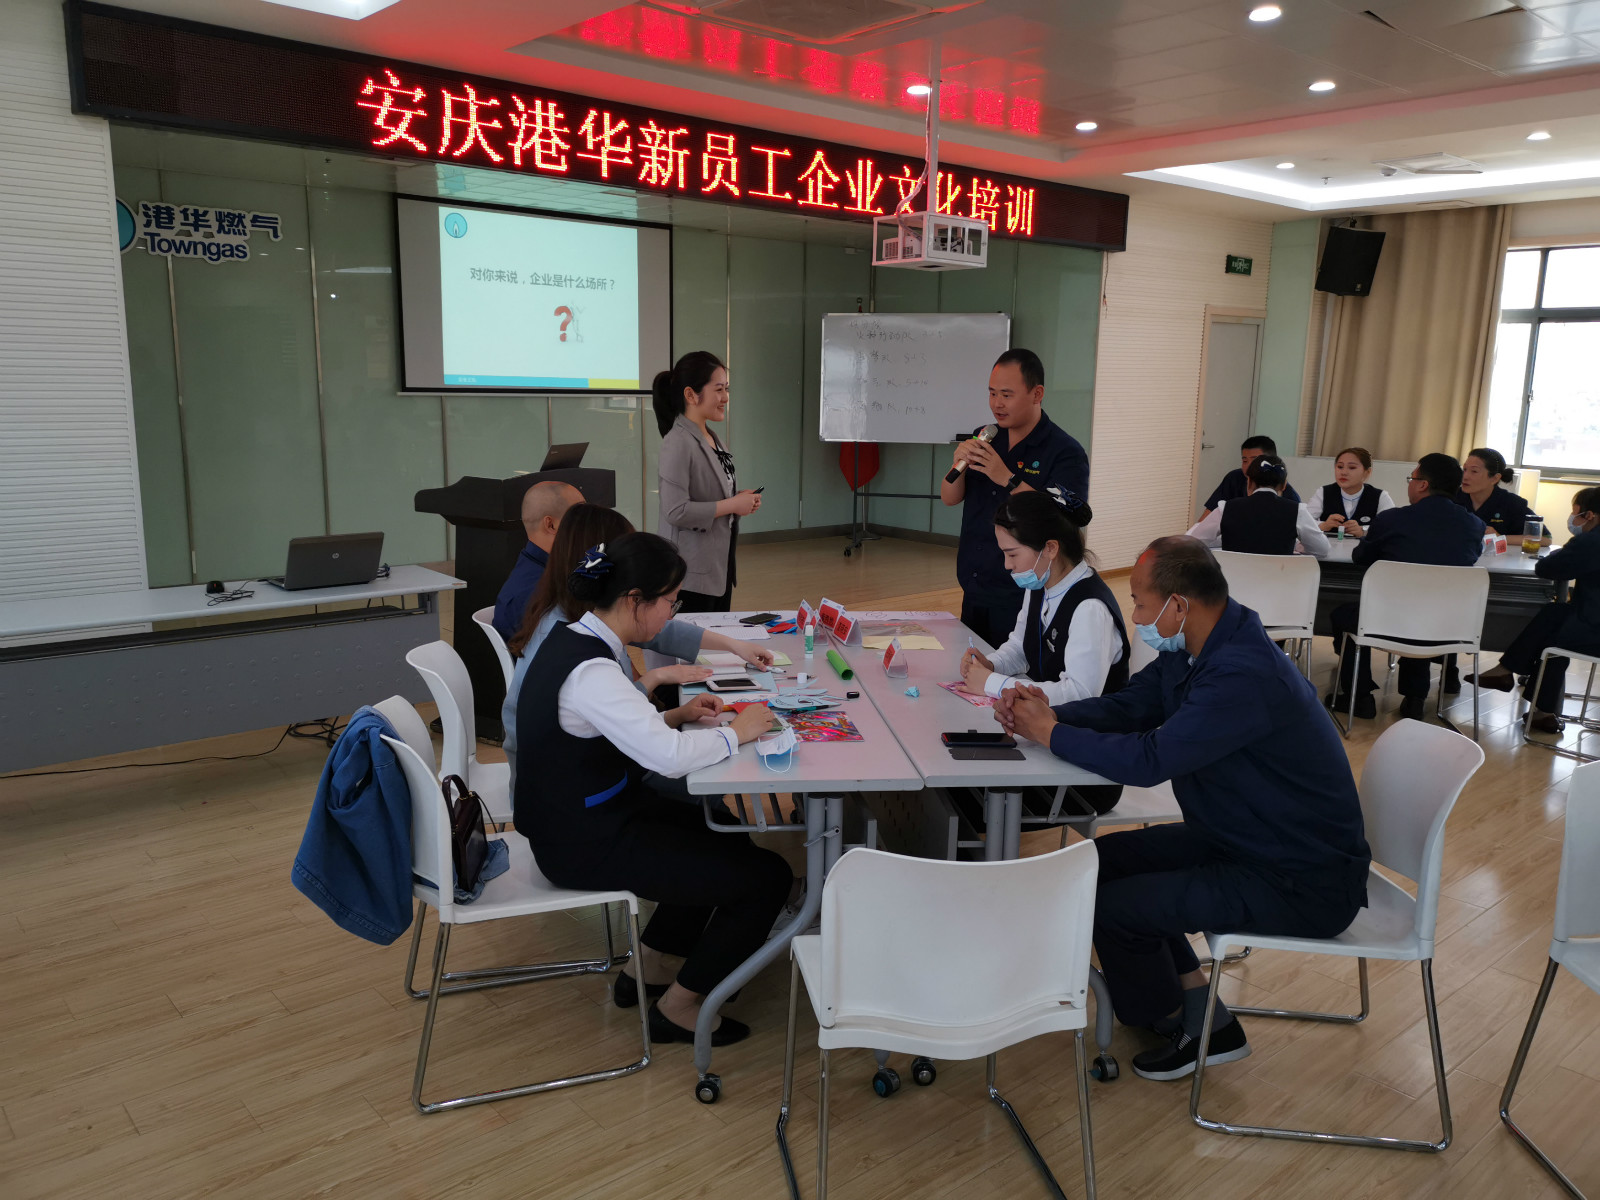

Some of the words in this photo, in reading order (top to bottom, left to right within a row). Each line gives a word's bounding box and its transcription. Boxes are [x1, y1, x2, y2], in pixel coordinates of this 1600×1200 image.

[356, 68, 1036, 237] 安庆港华新员工企业文化培训
[141, 203, 281, 239] 港华燃气
[143, 231, 248, 262] Towngas
[469, 267, 616, 291] 对你来说，企业是什么场所？
